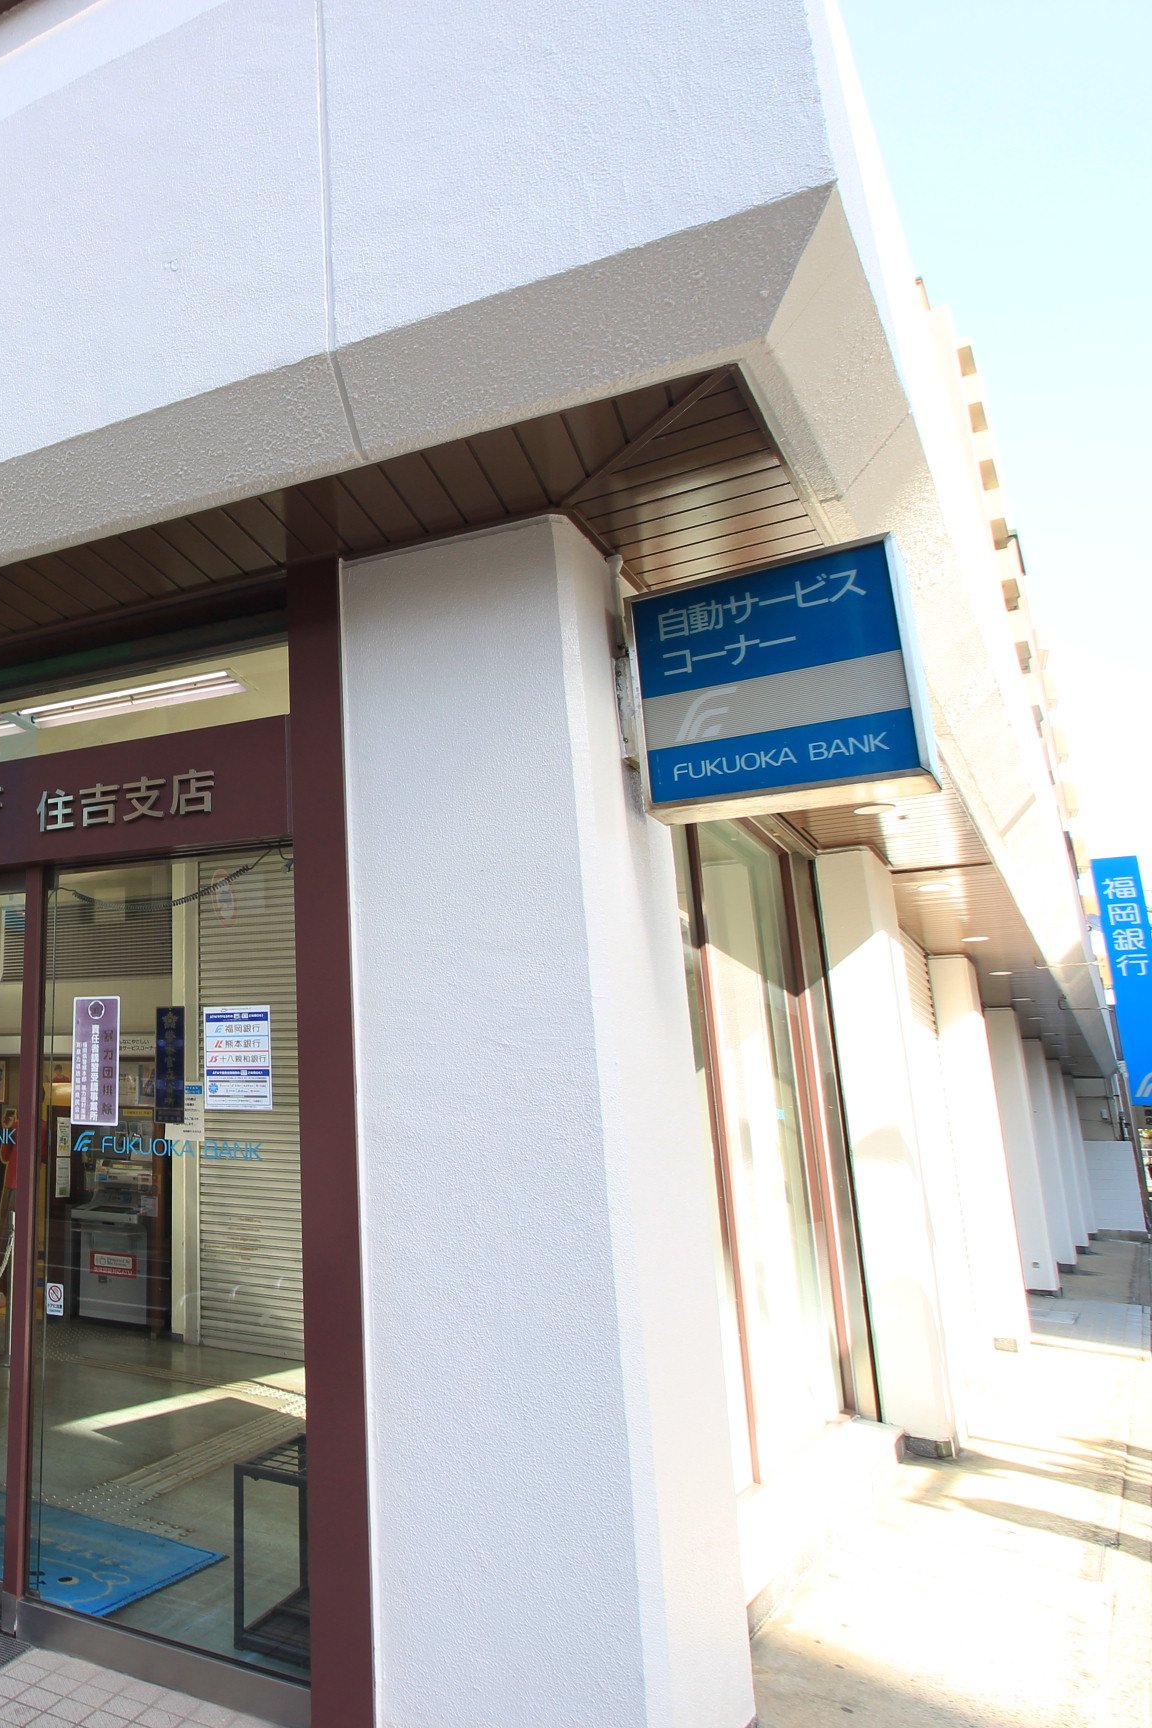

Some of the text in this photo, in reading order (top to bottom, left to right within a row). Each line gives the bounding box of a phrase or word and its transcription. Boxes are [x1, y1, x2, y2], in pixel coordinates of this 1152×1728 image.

[658, 569, 867, 642] 自動サービス
[662, 634, 797, 677] コーナー
[673, 731, 890, 782] FUKUOKA BANK
[36, 768, 216, 834] 住吉支店
[1102, 875, 1150, 977] 福岡銀行
[224, 1023, 261, 1033] 福岡銀行
[224, 1039, 262, 1049] 熊本銀行
[102, 1029, 114, 1116] 暴力団排除
[219, 1055, 267, 1064] 十八親和銀行
[101, 1135, 263, 1162] FUKUOKA BANK
